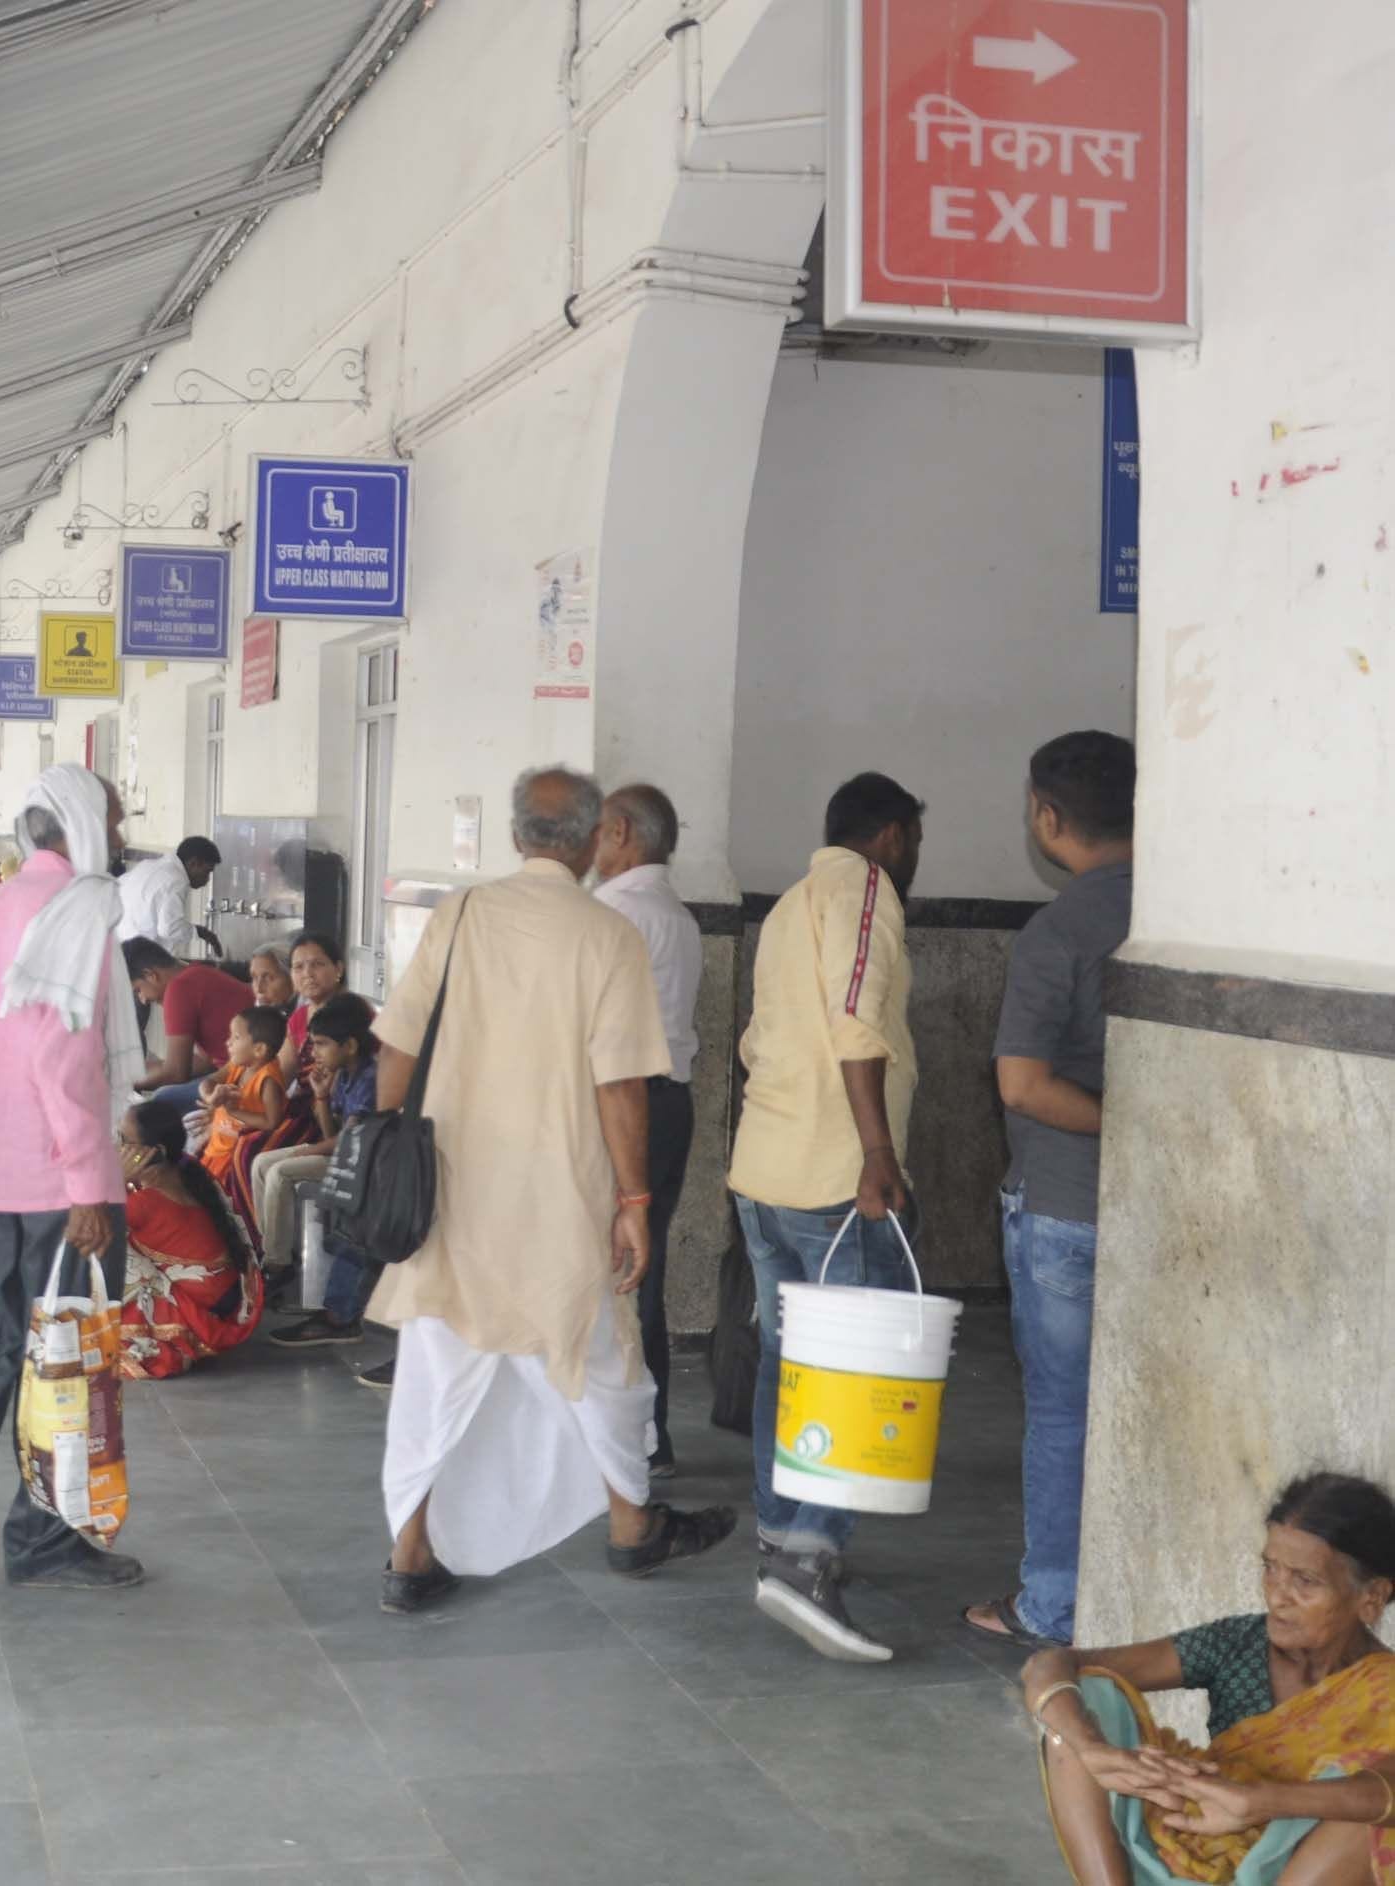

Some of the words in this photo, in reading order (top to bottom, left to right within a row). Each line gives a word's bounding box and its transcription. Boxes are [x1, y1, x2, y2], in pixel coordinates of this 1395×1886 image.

[909, 94, 1142, 181] निकास
[930, 185, 1127, 252] EXIT
[276, 543, 303, 561] उच्च
[304, 539, 330, 561] श्रेणी
[332, 540, 389, 564] प्रतीक्षालय
[275, 568, 302, 586] UPPER
[303, 569, 329, 587] CLASS
[331, 570, 364, 588] WAITING
[365, 571, 389, 589] ROOM
